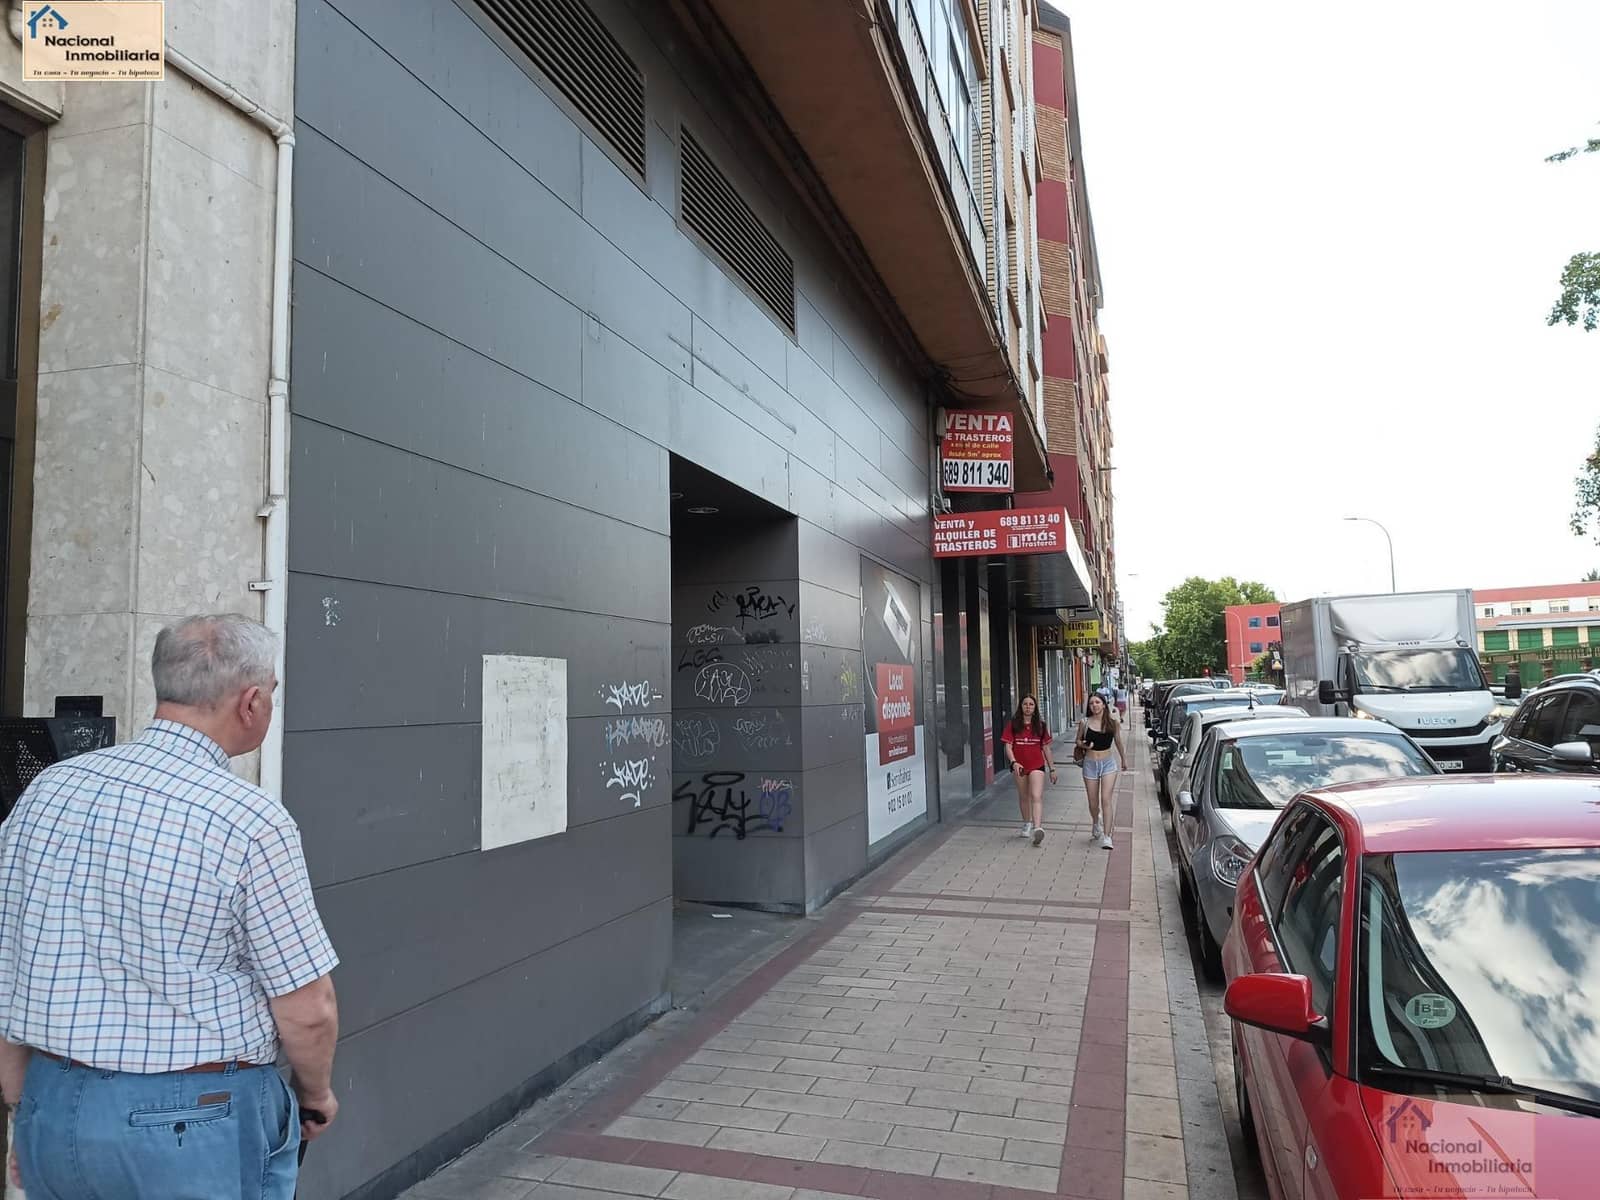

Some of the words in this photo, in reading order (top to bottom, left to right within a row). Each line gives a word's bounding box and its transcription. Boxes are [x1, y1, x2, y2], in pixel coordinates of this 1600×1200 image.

[946, 414, 1011, 431] VENTA
[955, 433, 1012, 442] TRASTEROS
[945, 461, 959, 484] 689
[963, 462, 982, 484] 811
[987, 462, 1009, 485] 340
[934, 519, 965, 530] VENTA
[1000, 516, 1018, 526] 689
[935, 530, 980, 542] ALQUILER
[984, 529, 997, 538] DE
[1021, 530, 1057, 542] más
[935, 539, 997, 552] TRASTEROS
[888, 668, 904, 690] Local
[882, 695, 911, 726] disponible
[1417, 718, 1457, 726] IVECO
[1422, 1004, 1431, 1013] B
